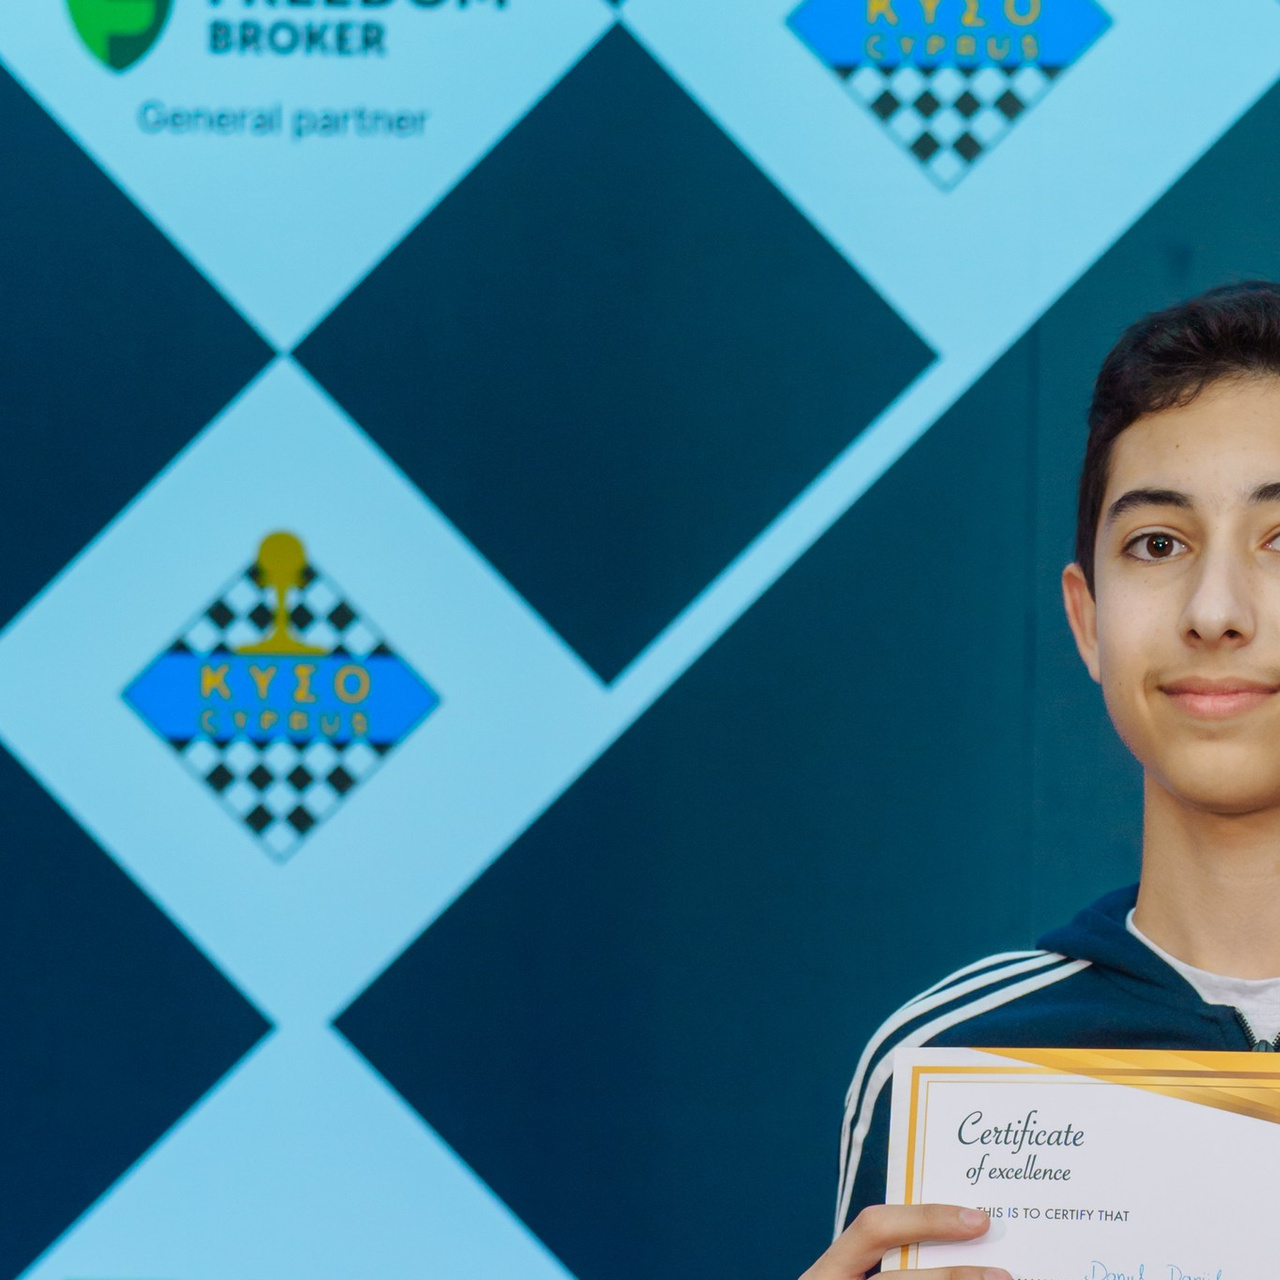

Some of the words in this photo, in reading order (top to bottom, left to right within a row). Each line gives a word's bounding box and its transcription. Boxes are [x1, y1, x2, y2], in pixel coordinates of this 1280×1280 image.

[208, 19, 388, 58] BROKER
[137, 100, 283, 136] General
[291, 105, 429, 142] partner
[957, 1110, 1085, 1154] Certificate
[966, 1153, 990, 1185] of
[988, 1154, 1072, 1181] excellence
[1007, 1207, 1019, 1219] IS
[1023, 1208, 1041, 1219] TO
[1045, 1208, 1094, 1221] CERTIFY
[1098, 1209, 1130, 1222] THAT
